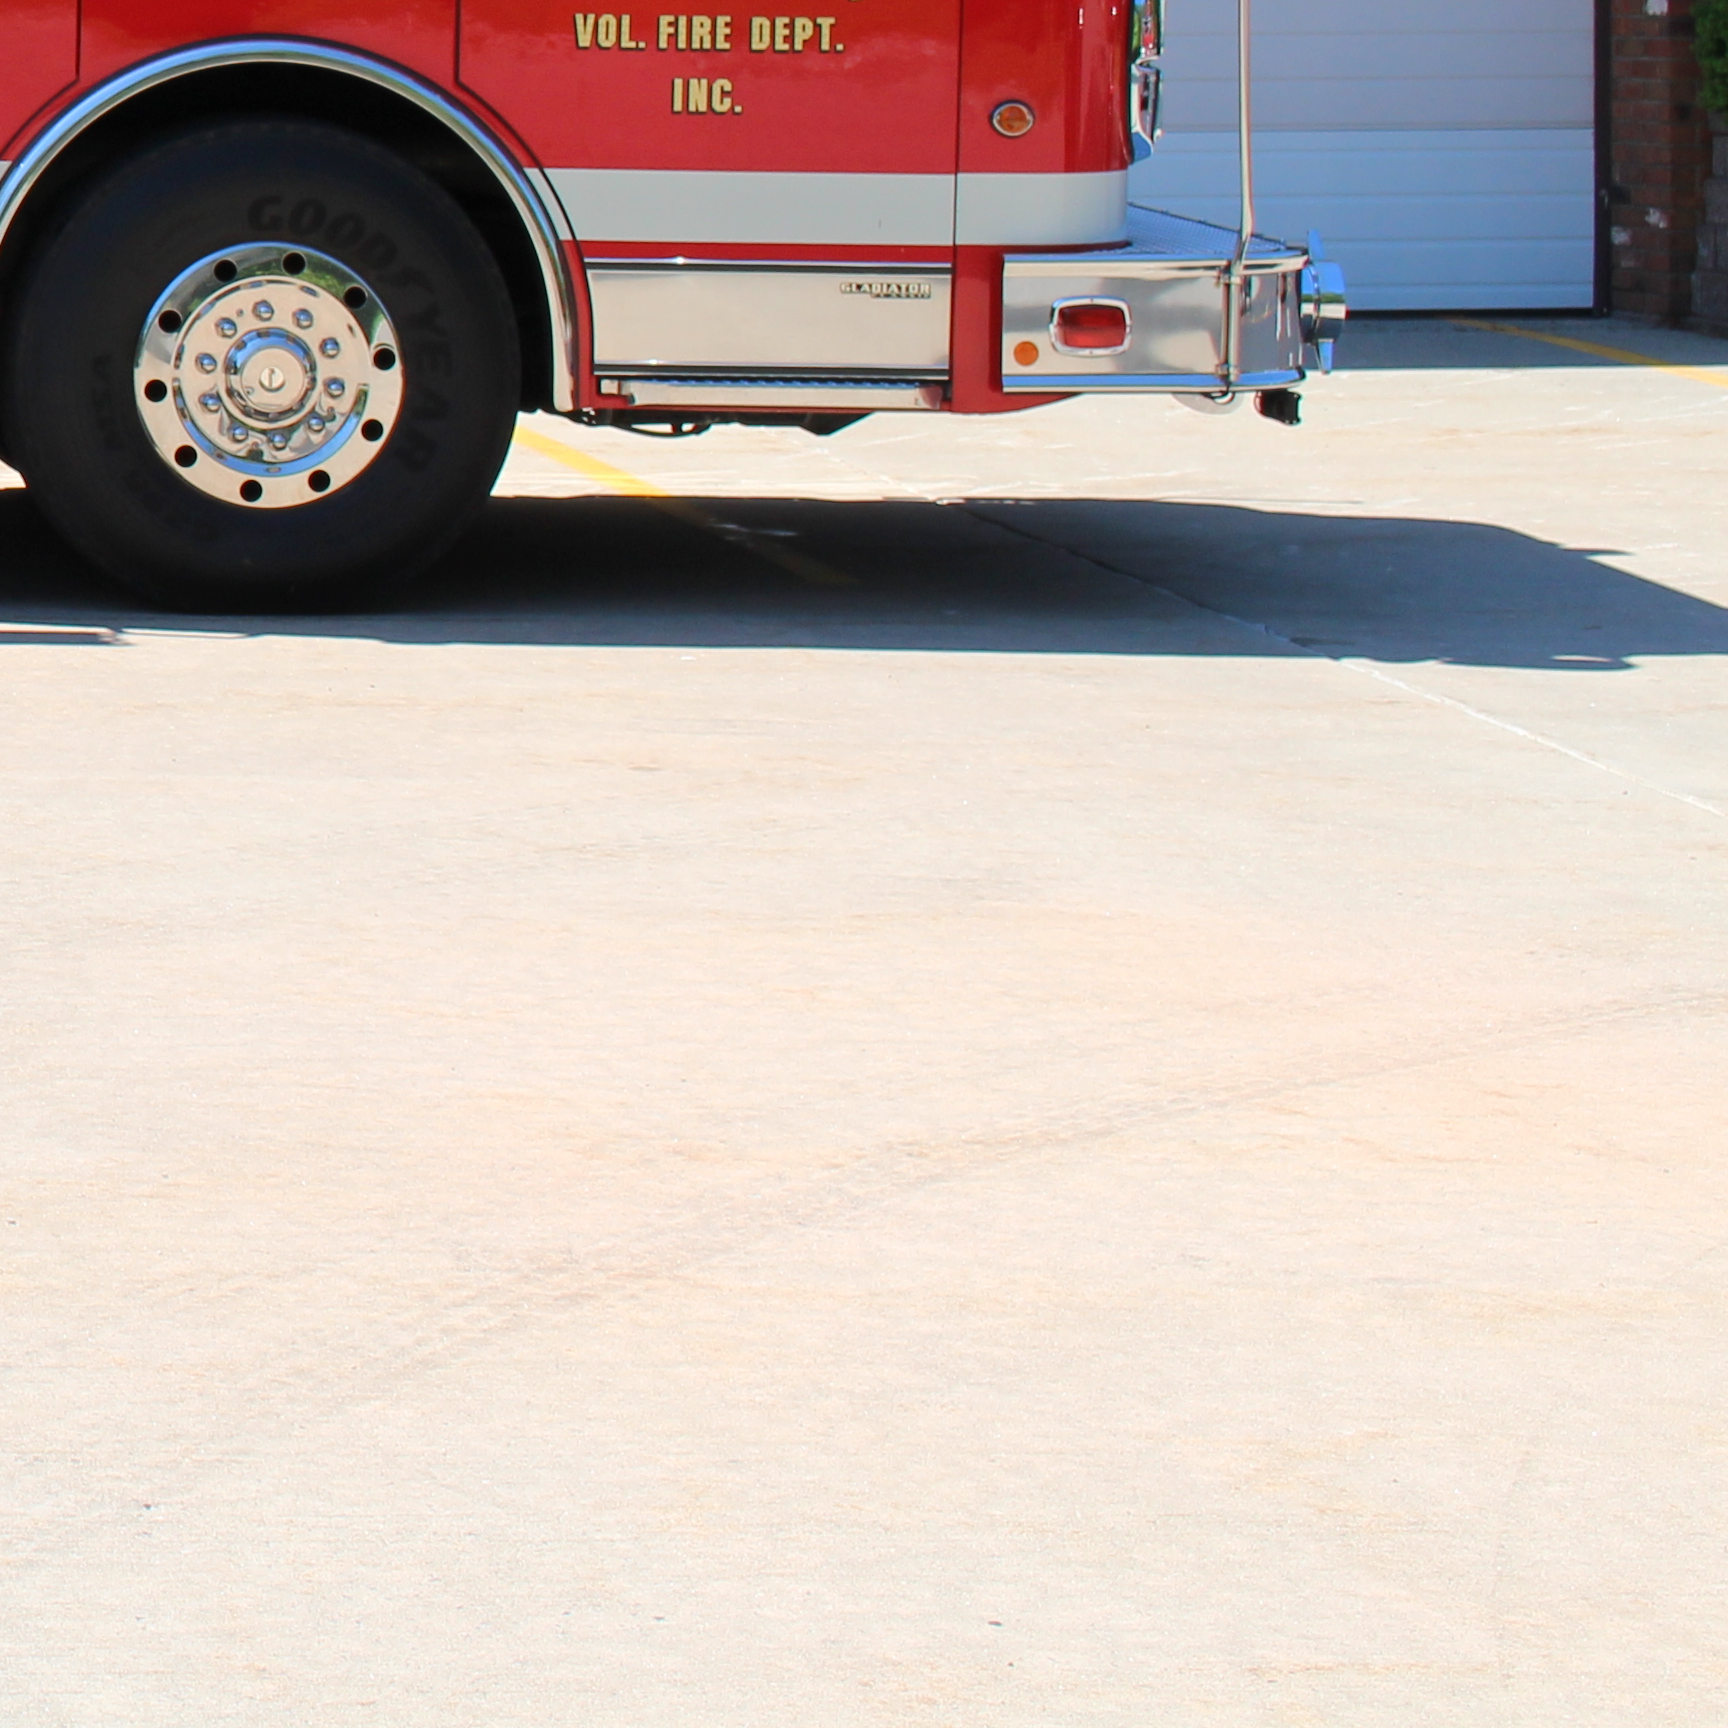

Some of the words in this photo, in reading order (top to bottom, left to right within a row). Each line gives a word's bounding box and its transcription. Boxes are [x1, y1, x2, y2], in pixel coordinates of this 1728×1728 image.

[574, 13, 646, 49] VOL.
[657, 15, 731, 50] FIRE
[750, 16, 844, 52] DEPT.
[672, 78, 742, 114] INC.
[840, 282, 931, 294] GLADIATOR
[246, 194, 454, 475] GOODYEAR
